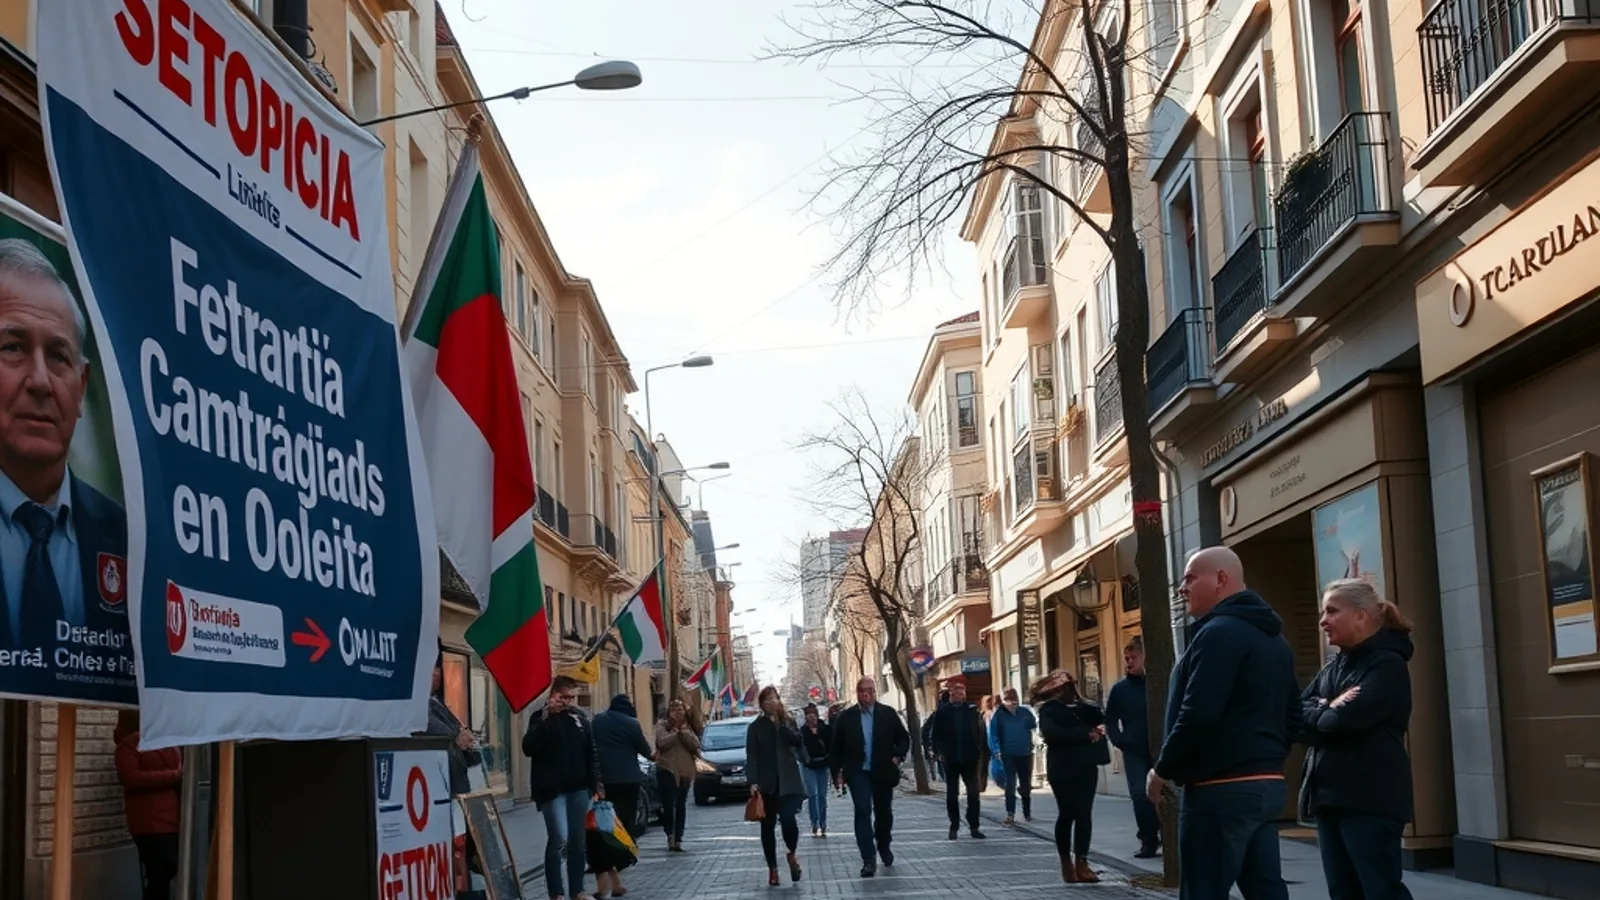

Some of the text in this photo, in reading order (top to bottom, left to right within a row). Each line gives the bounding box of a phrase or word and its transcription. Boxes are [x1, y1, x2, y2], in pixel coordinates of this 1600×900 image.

[114, 0, 361, 243] SETOPICIA
[173, 484, 376, 597] en Ooleita
